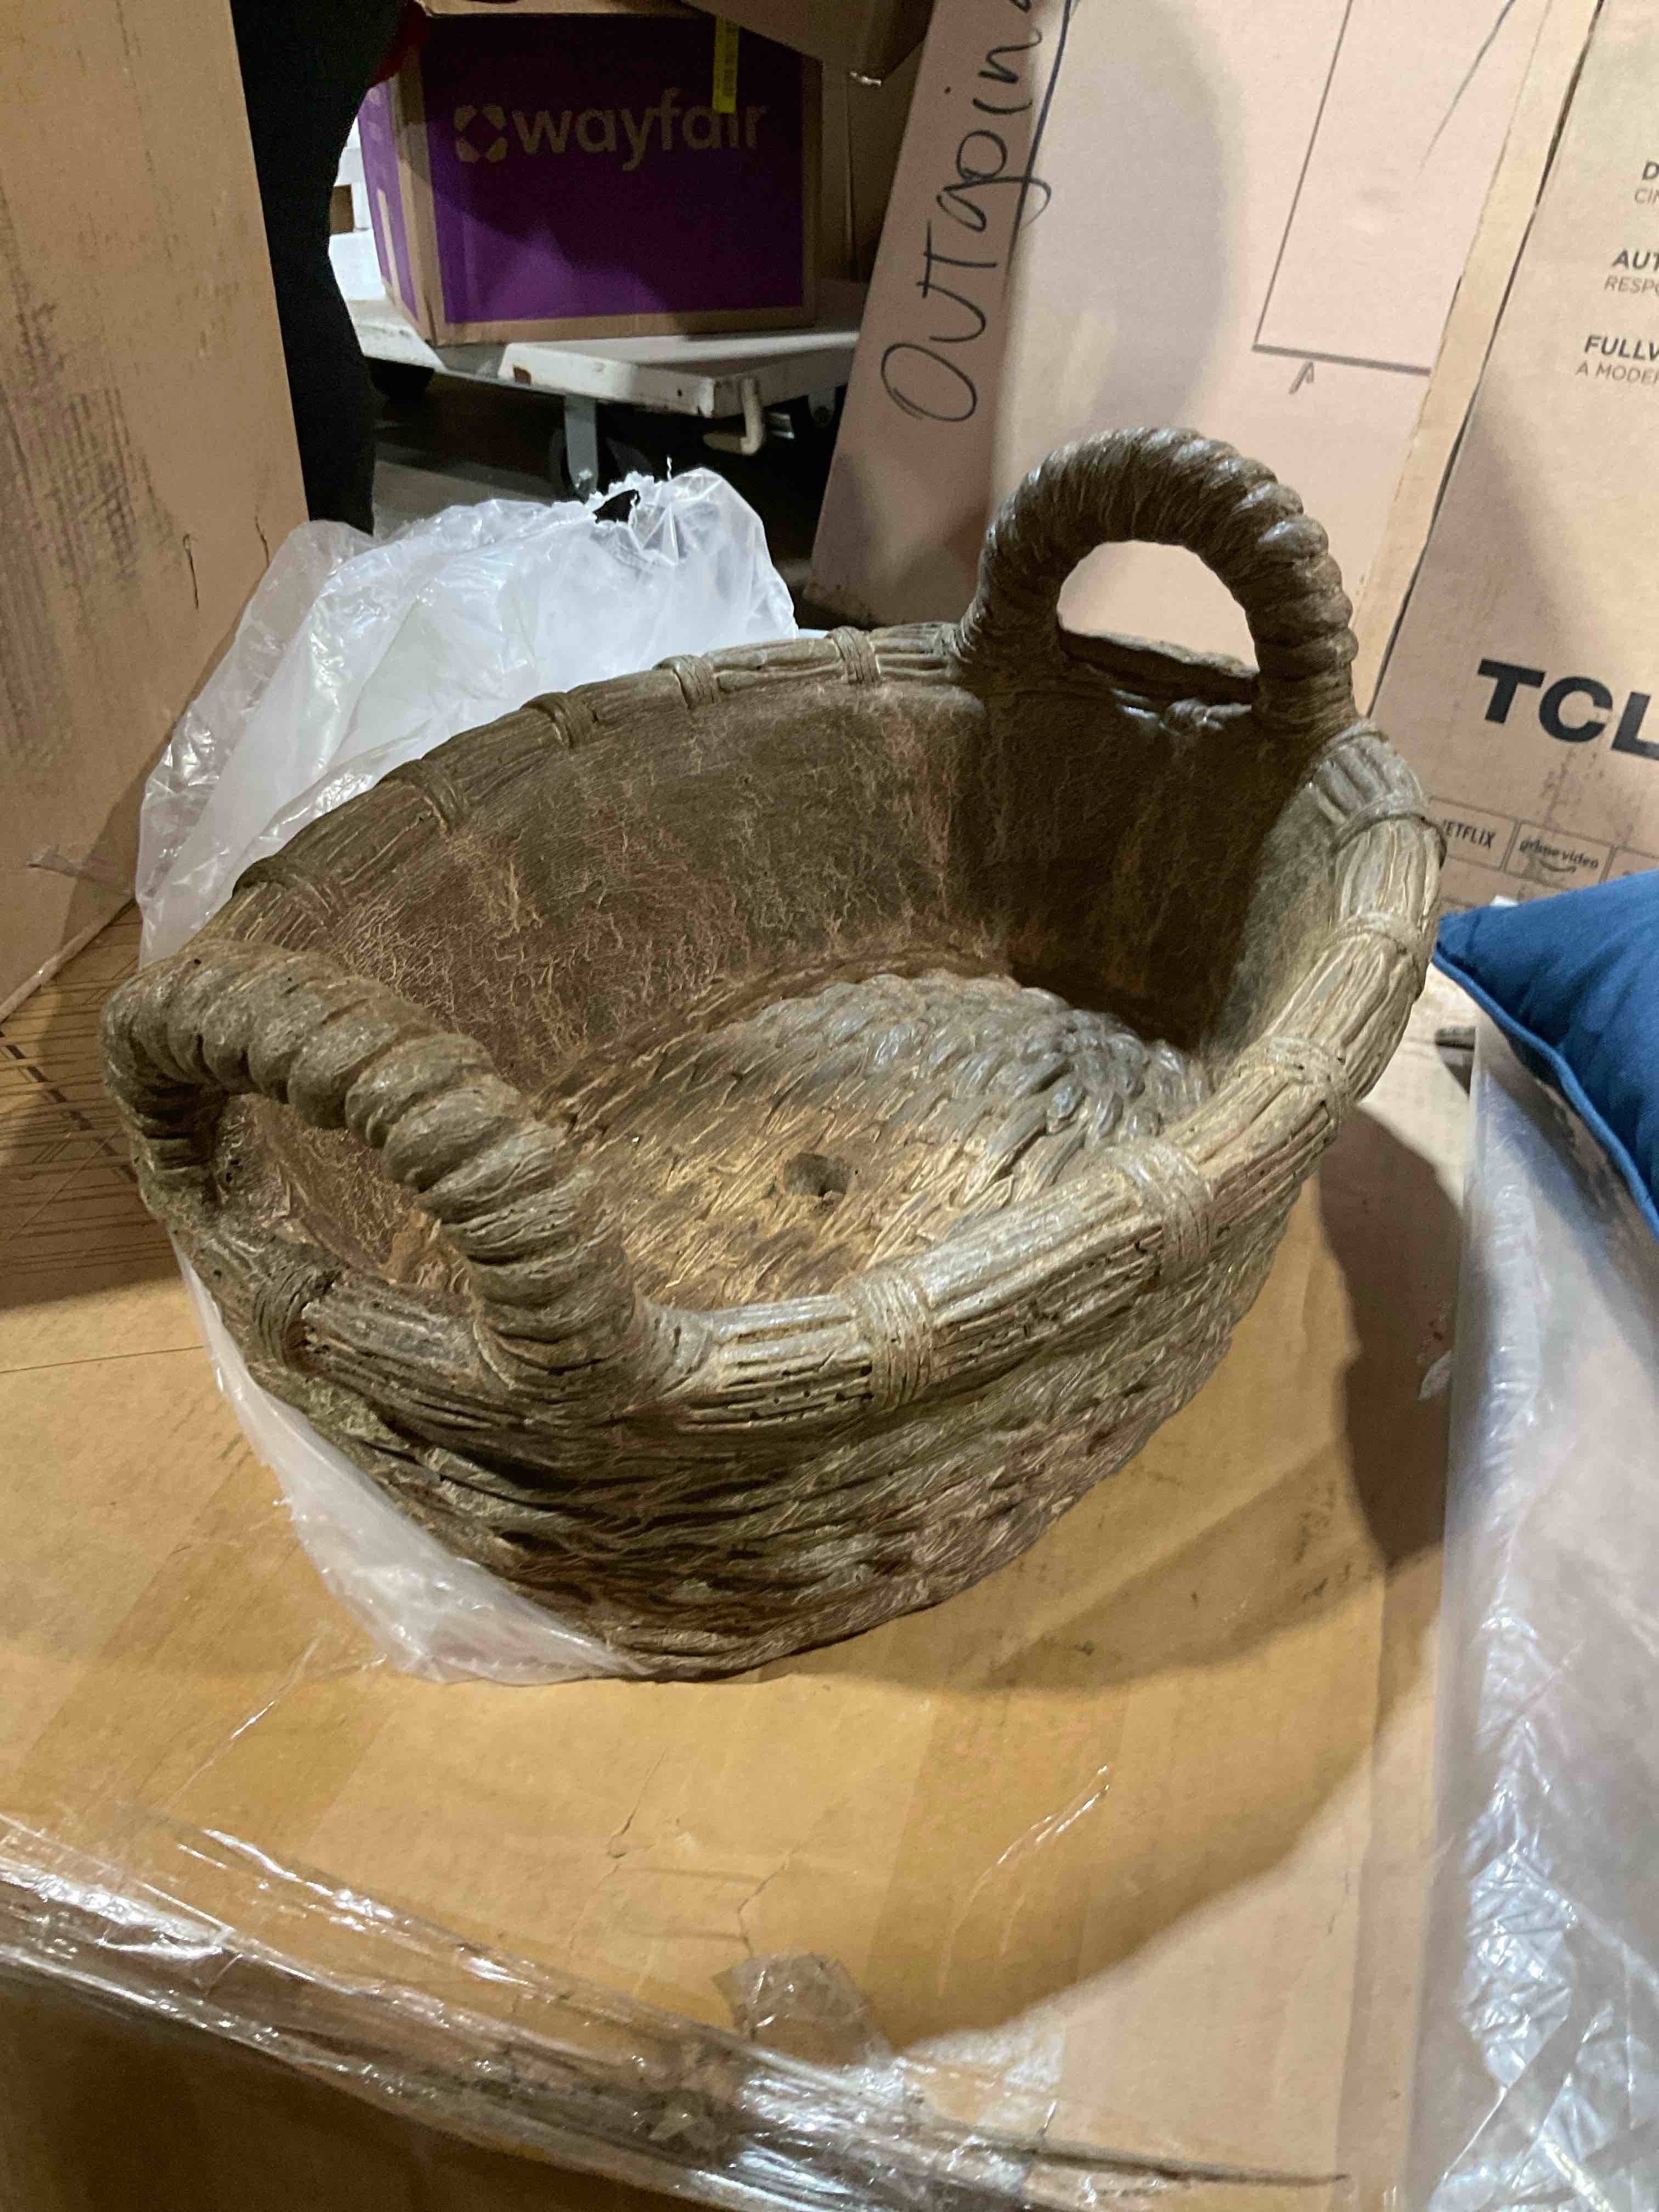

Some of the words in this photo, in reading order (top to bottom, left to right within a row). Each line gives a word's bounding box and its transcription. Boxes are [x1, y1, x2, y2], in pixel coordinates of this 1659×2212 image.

[512, 88, 767, 171] wayfair
[881, 0, 1064, 422] OUTgoin
[1575, 361, 1589, 376] A
[1477, 658, 1659, 760] TCL
[1443, 820, 1496, 849] ETFLIX
[1562, 849, 1599, 870] video
